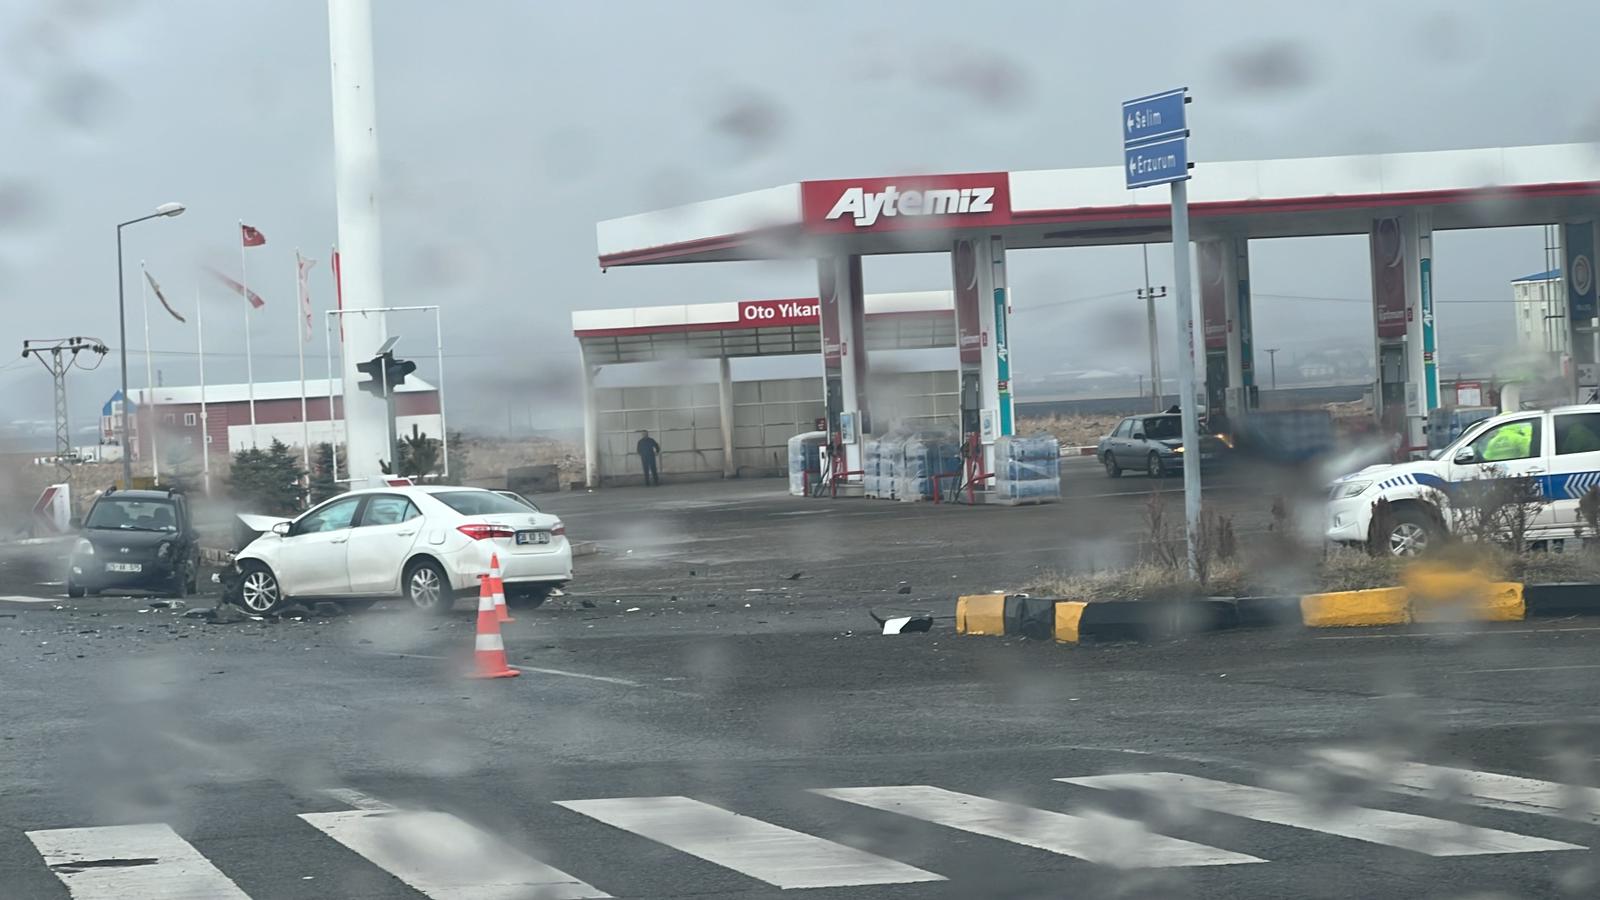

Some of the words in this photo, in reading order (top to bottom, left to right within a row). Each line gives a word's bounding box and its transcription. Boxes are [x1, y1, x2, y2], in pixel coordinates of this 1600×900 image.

[1135, 109, 1162, 128] Selim
[1137, 155, 1176, 173] Erzurum
[825, 185, 995, 227] Aytemiz
[744, 305, 775, 319] Oto
